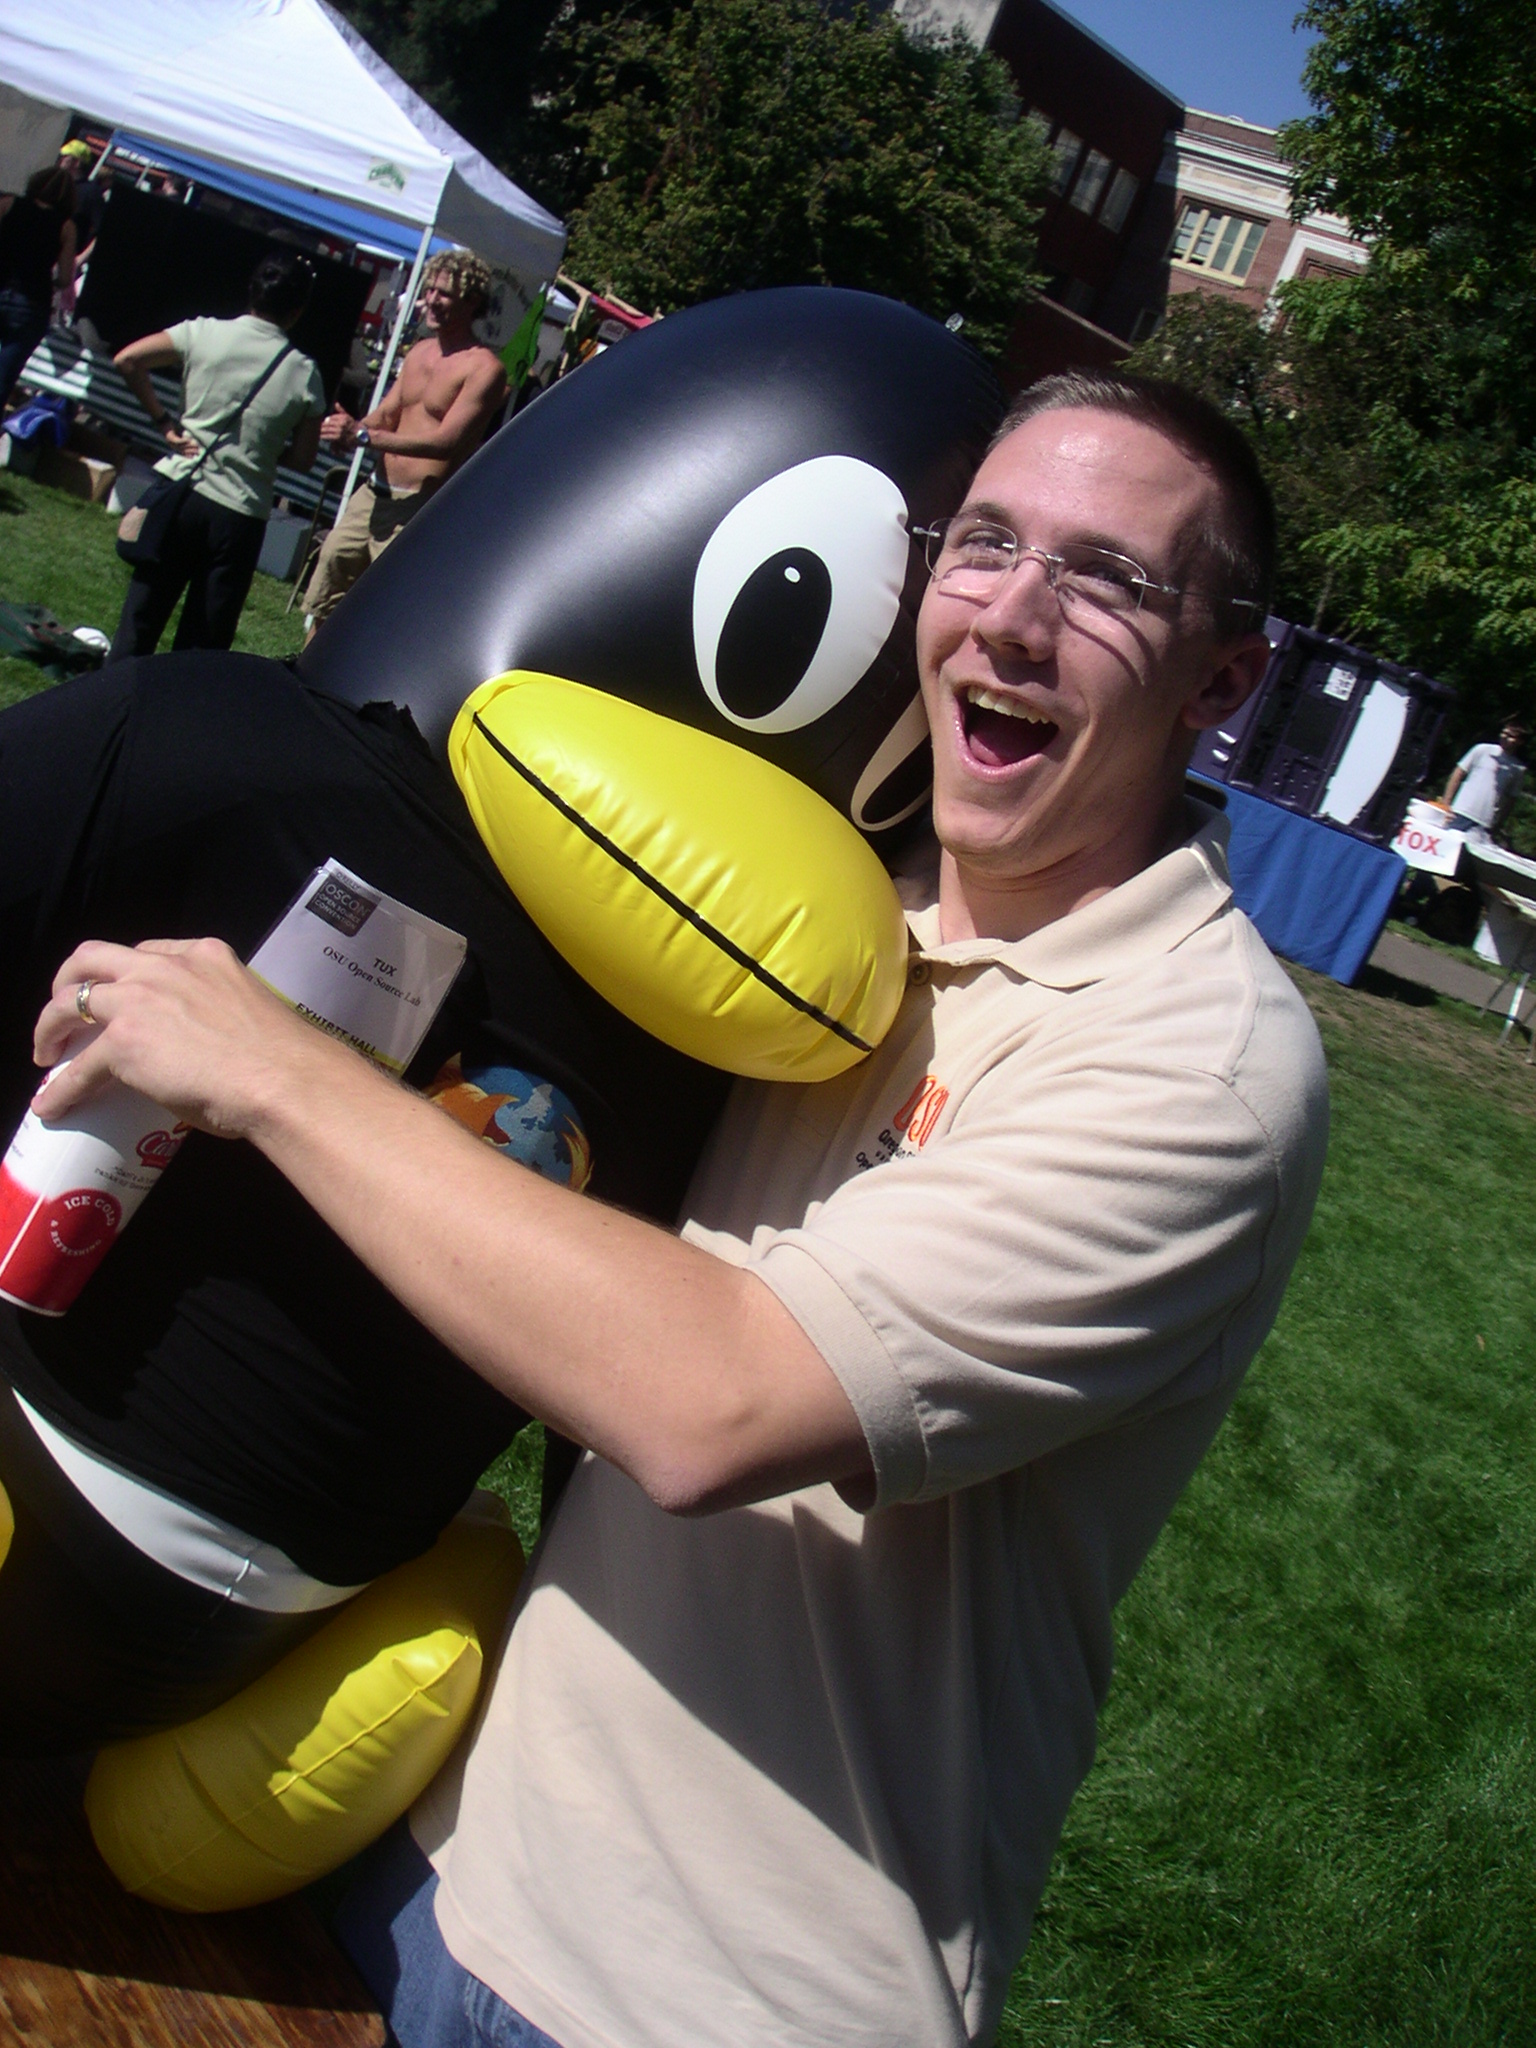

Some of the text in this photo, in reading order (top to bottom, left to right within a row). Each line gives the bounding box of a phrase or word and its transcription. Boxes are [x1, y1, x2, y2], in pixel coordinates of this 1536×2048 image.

[314, 899, 357, 930] CONVENTION
[319, 893, 336, 908] OPEN
[325, 884, 371, 916] OSCON
[323, 946, 421, 1007] OSU Open Source Lab
[373, 957, 397, 977] TUX
[350, 1035, 377, 1056] HALL
[64, 1195, 116, 1227] ICE COLD
